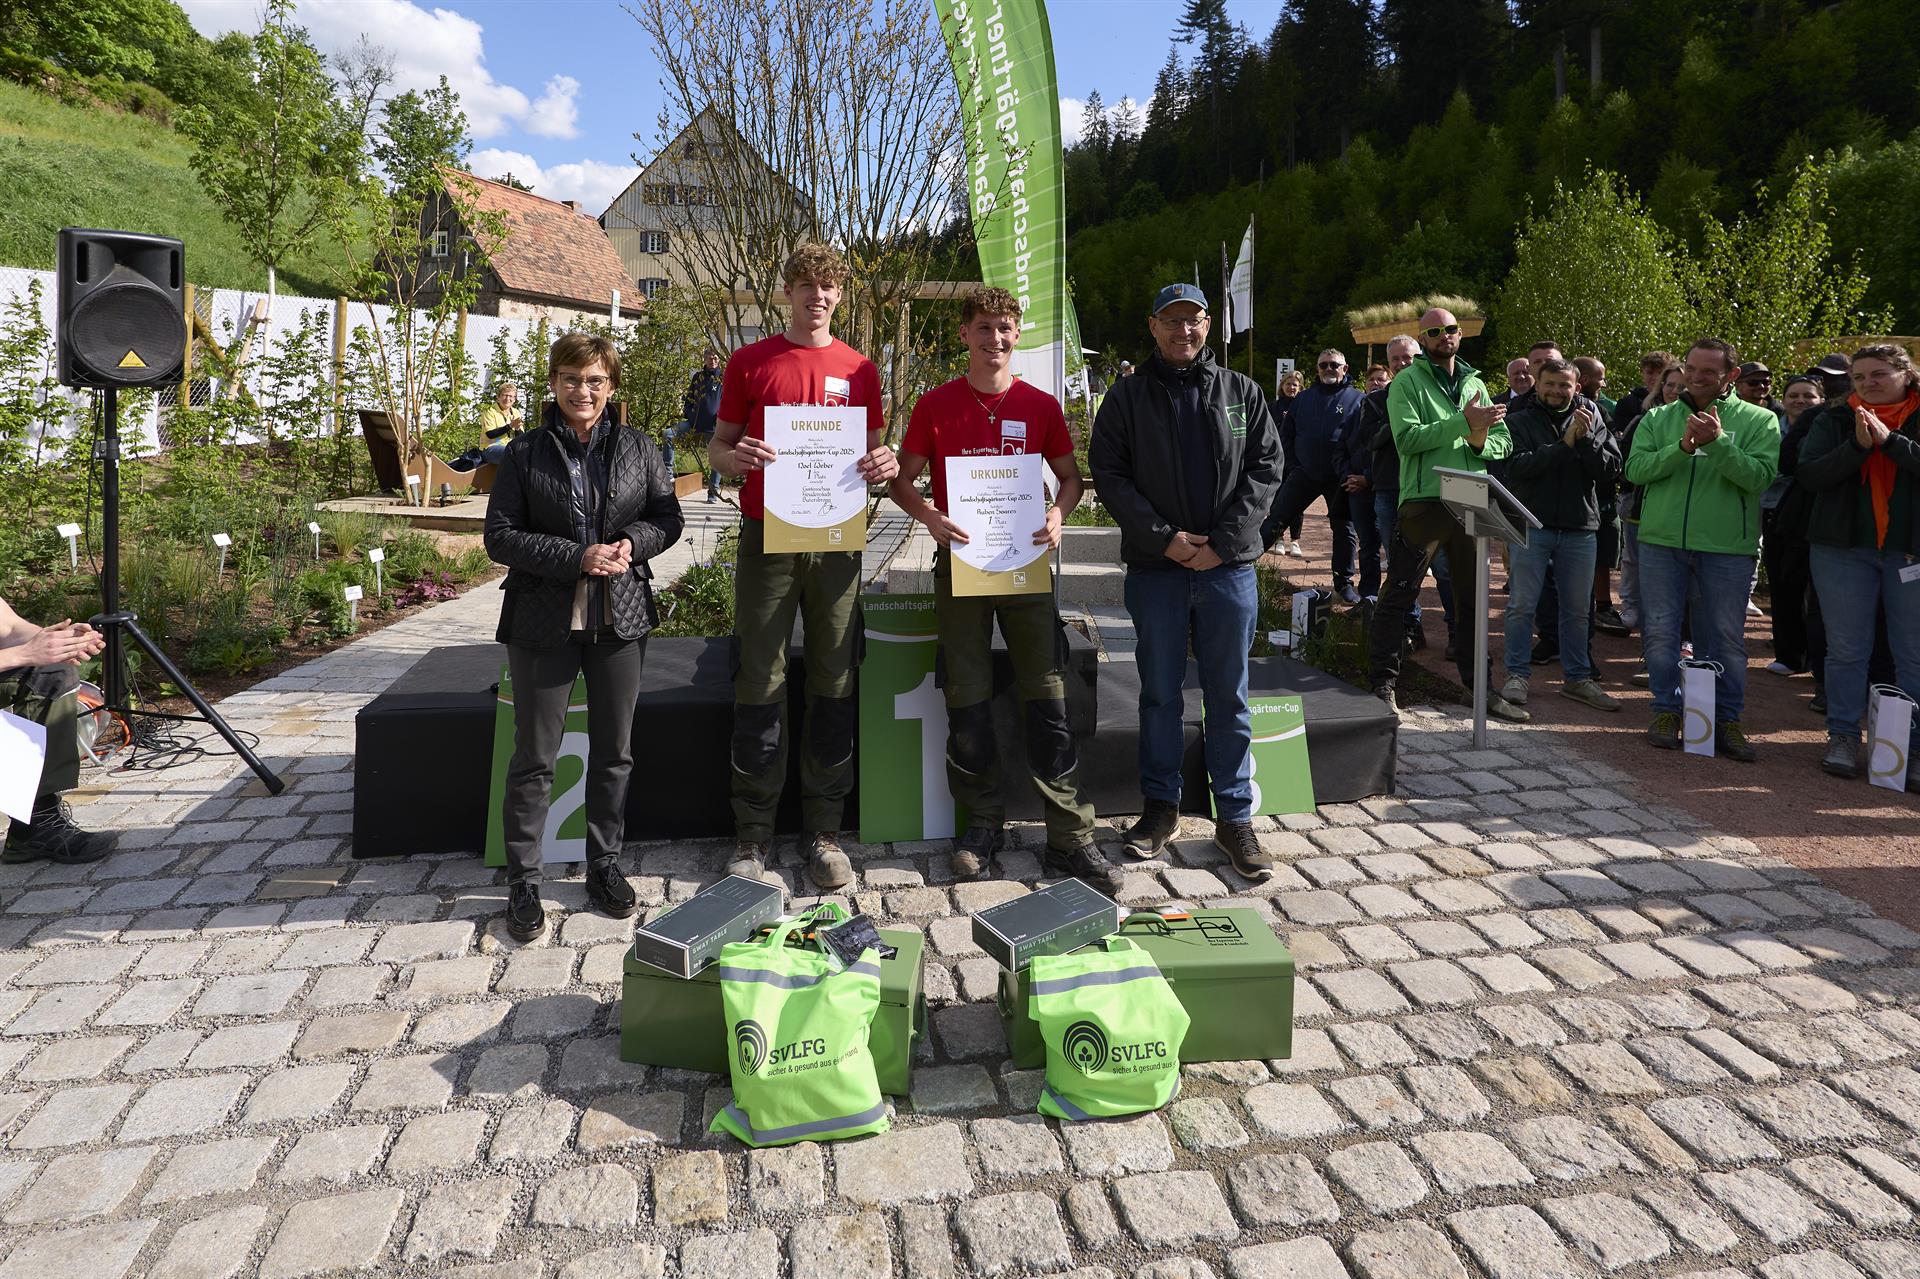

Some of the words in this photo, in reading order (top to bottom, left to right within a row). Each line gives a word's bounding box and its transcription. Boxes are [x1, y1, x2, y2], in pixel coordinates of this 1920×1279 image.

[791, 420, 842, 431] URKUNDE
[971, 468, 1019, 479] URKUNDE
[1018, 493, 1032, 501] 2025
[863, 600, 936, 611] Landschaftsgärt
[1249, 703, 1300, 715] sgärtner-Cup
[895, 672, 955, 840] 1
[692, 940, 709, 954] SWAY
[710, 928, 727, 943] TABLE
[1019, 941, 1037, 953] SWAY
[1038, 933, 1056, 944] TABLE
[768, 1038, 826, 1065] SVLFG
[1111, 1041, 1167, 1063] SVLFG
[767, 1066, 787, 1077] sicher
[788, 1064, 793, 1073] &
[794, 1061, 818, 1074] gesund
[820, 1059, 832, 1068] aus
[1112, 1065, 1132, 1075] sicher
[1133, 1065, 1137, 1073] &
[1139, 1062, 1161, 1073] gesund
[1162, 1061, 1173, 1069] aus
